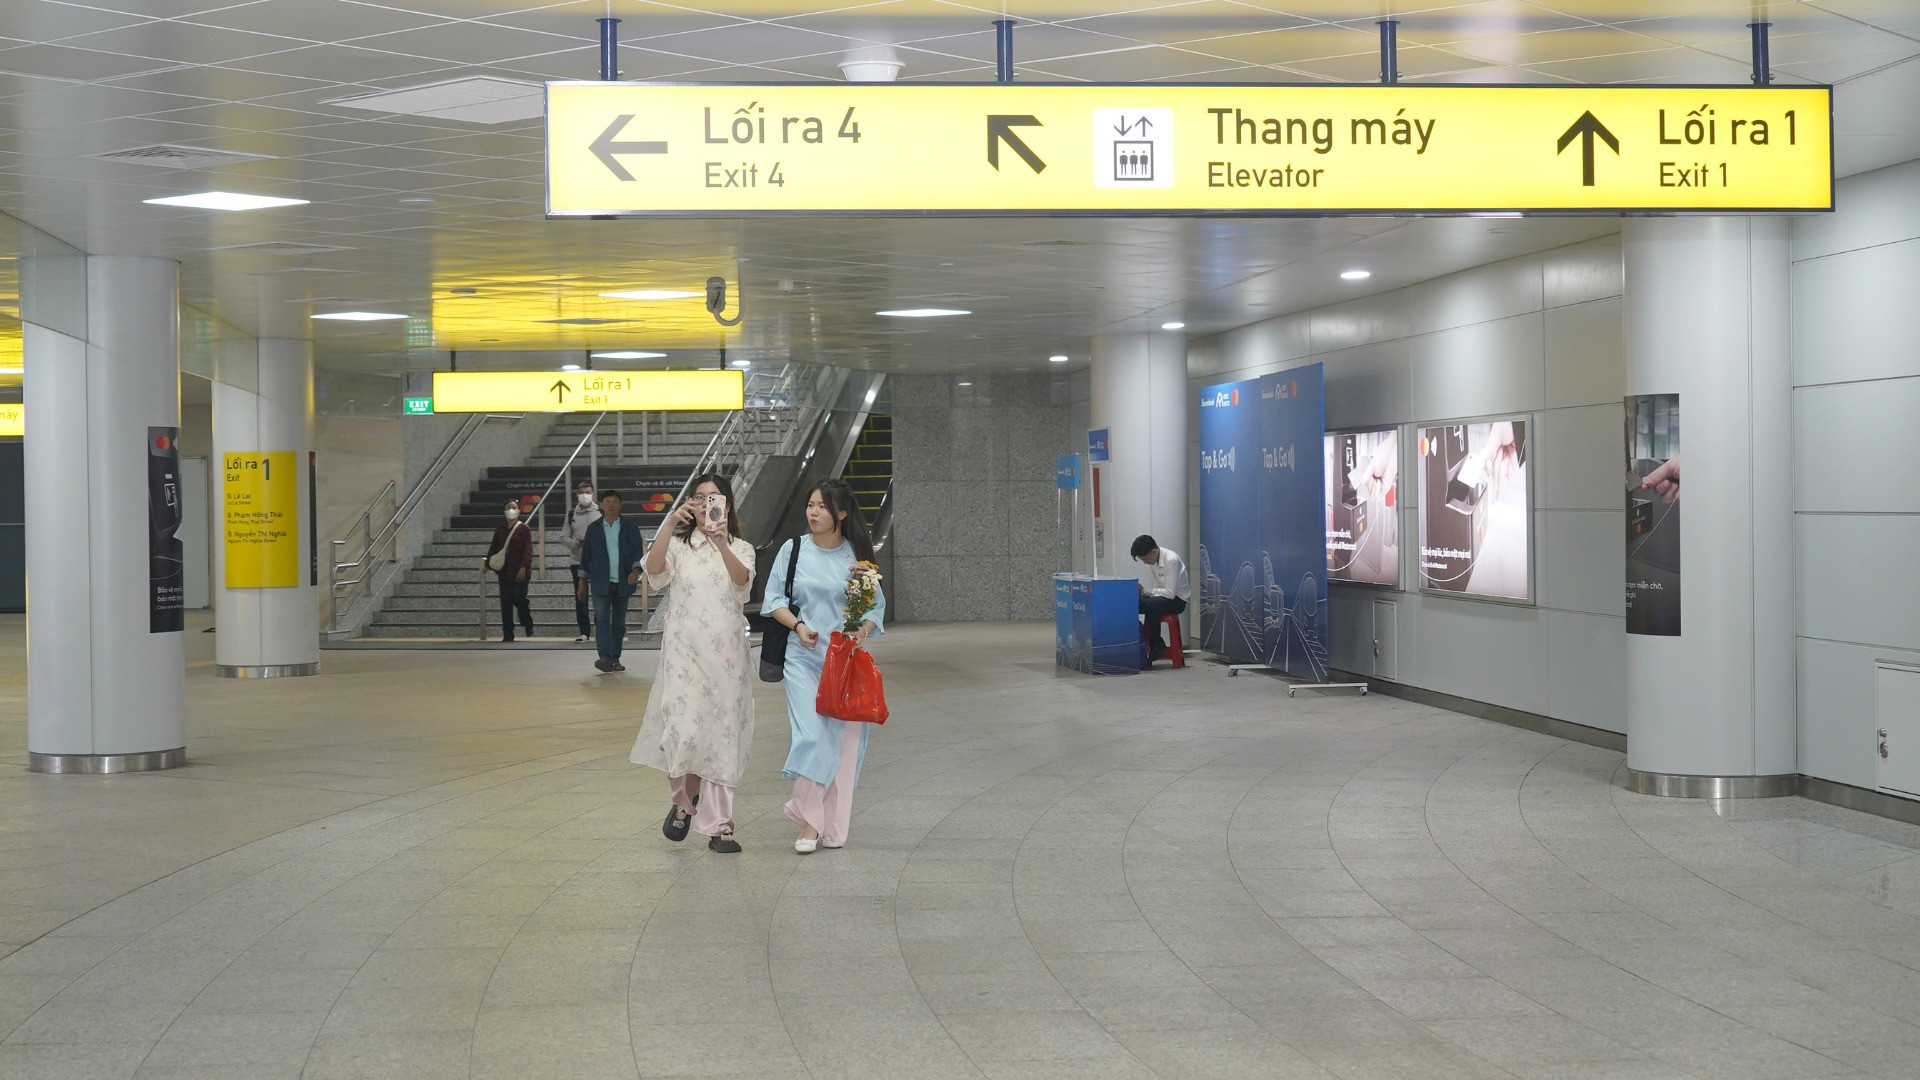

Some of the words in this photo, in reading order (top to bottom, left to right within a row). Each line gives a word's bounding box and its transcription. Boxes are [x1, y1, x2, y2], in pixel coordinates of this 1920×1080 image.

[704, 102, 765, 144] Lối
[782, 117, 823, 144] ra
[837, 107, 862, 144] 4
[1207, 108, 1333, 155] Thang
[1351, 108, 1436, 155] máy
[1658, 104, 1716, 145] Lối
[1731, 120, 1769, 146] ra
[1784, 110, 1796, 146] 1
[705, 162, 759, 188] Exit
[767, 162, 785, 188] 4
[1208, 162, 1325, 188] Elevator
[1659, 162, 1709, 188] Exit
[1719, 163, 1727, 188] 1
[584, 376, 604, 391] Lối
[608, 381, 623, 391] ra
[626, 378, 632, 391] 1
[409, 400, 429, 408] EXIT
[584, 396, 600, 404] Exit
[227, 457, 242, 469] Lối
[246, 461, 257, 469] ra
[263, 459, 270, 480] 1
[1202, 451, 1212, 473] Tap
[1219, 449, 1227, 468] Go
[1263, 448, 1272, 473] Tap
[1279, 446, 1287, 468] Go
